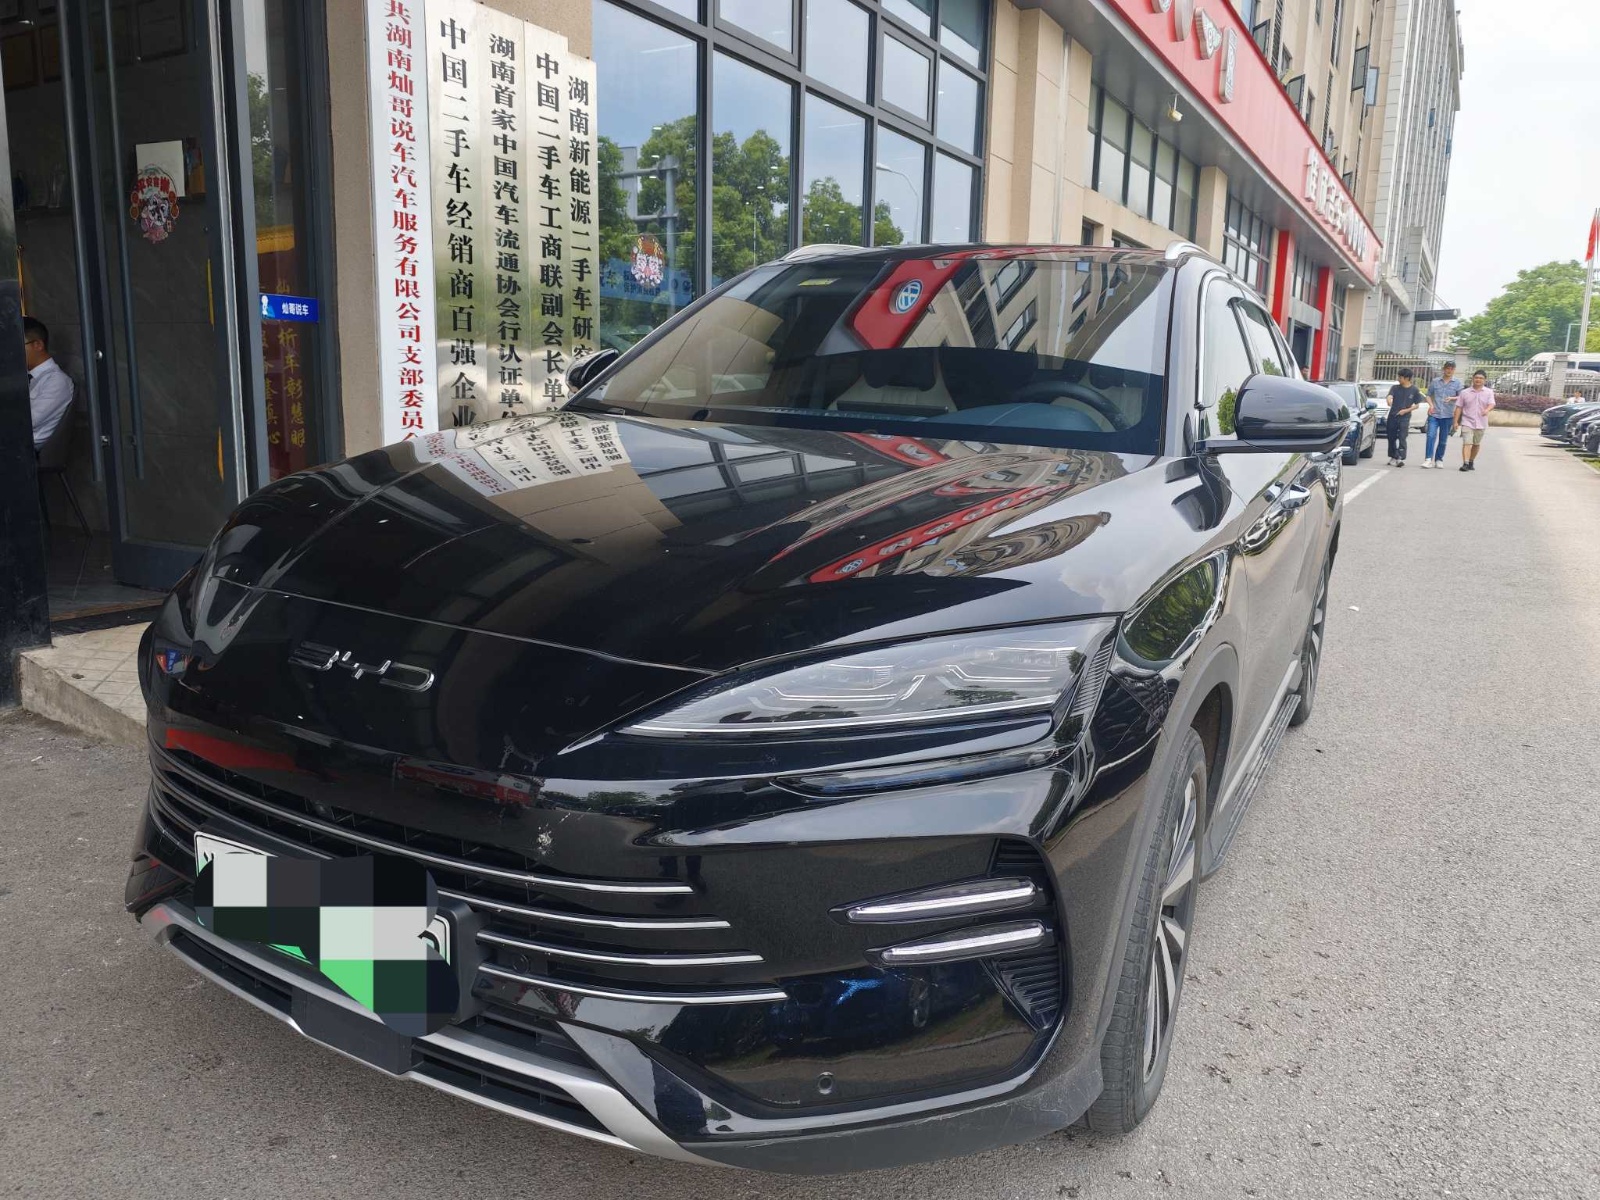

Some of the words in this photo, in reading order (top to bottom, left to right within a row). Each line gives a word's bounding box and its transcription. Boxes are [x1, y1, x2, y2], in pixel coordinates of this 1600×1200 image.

[282, 301, 310, 316] 灿哥说车
[384, 0, 424, 441] 共湖南灿哥说车汽车服务有限公司支部委员
[440, 18, 477, 427] 中国二手车经销商百强企业
[489, 33, 523, 418] 湖南首家中国汽车流通协会行认证单
[536, 52, 565, 412] 中国二手车工商联副会长单
[288, 641, 435, 692] BYD
